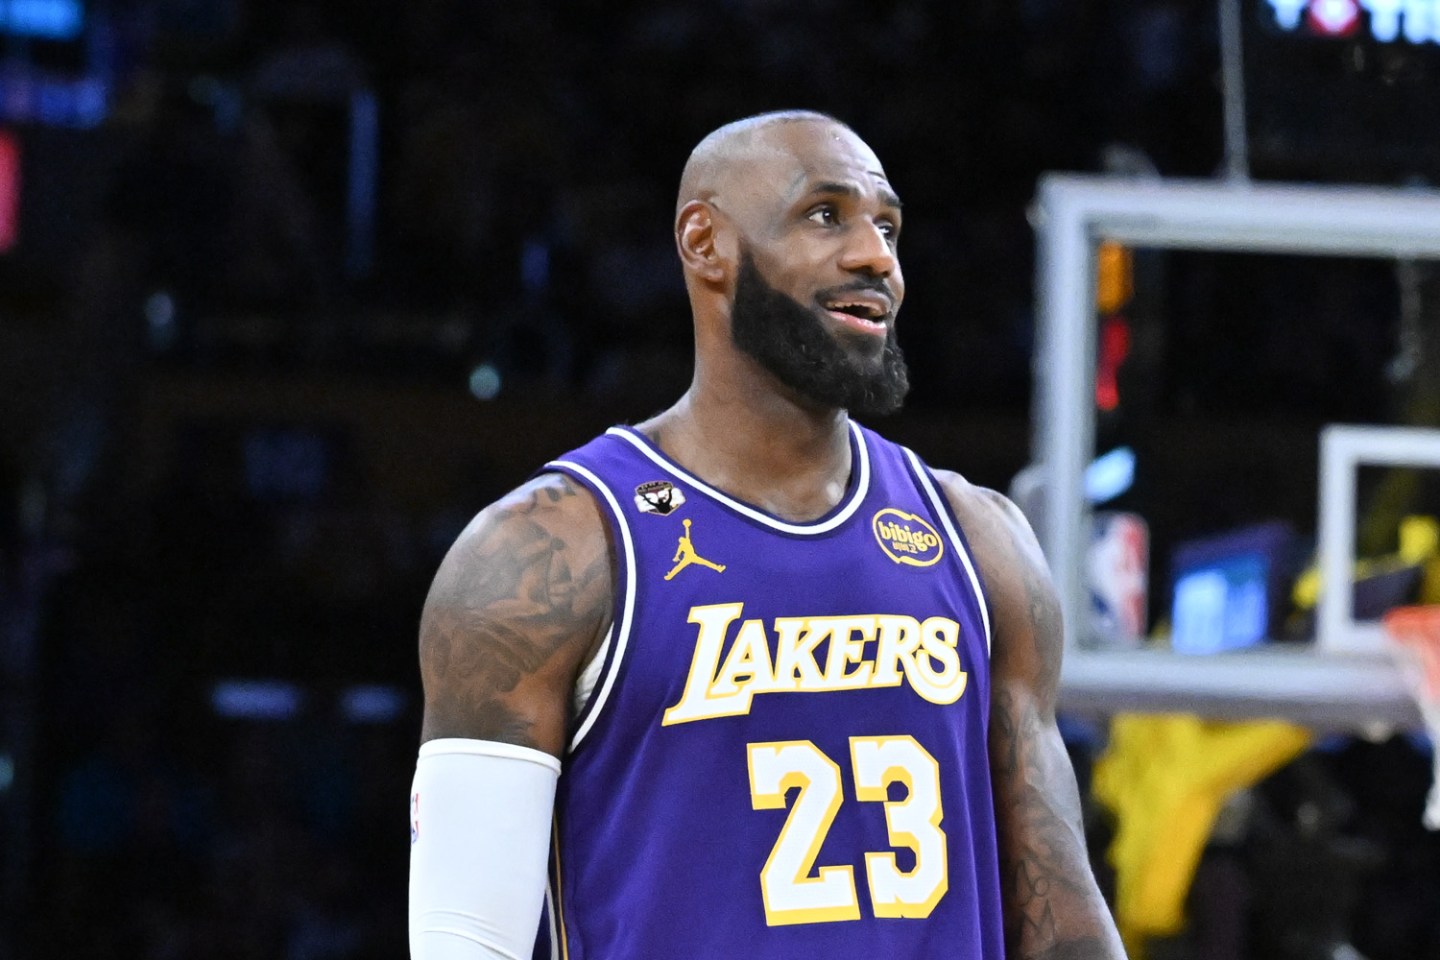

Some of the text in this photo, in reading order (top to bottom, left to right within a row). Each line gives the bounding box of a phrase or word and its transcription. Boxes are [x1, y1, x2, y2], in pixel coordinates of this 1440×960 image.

[877, 521, 937, 552] bibigo
[661, 601, 967, 727] LAKERS
[746, 735, 949, 926] 23
